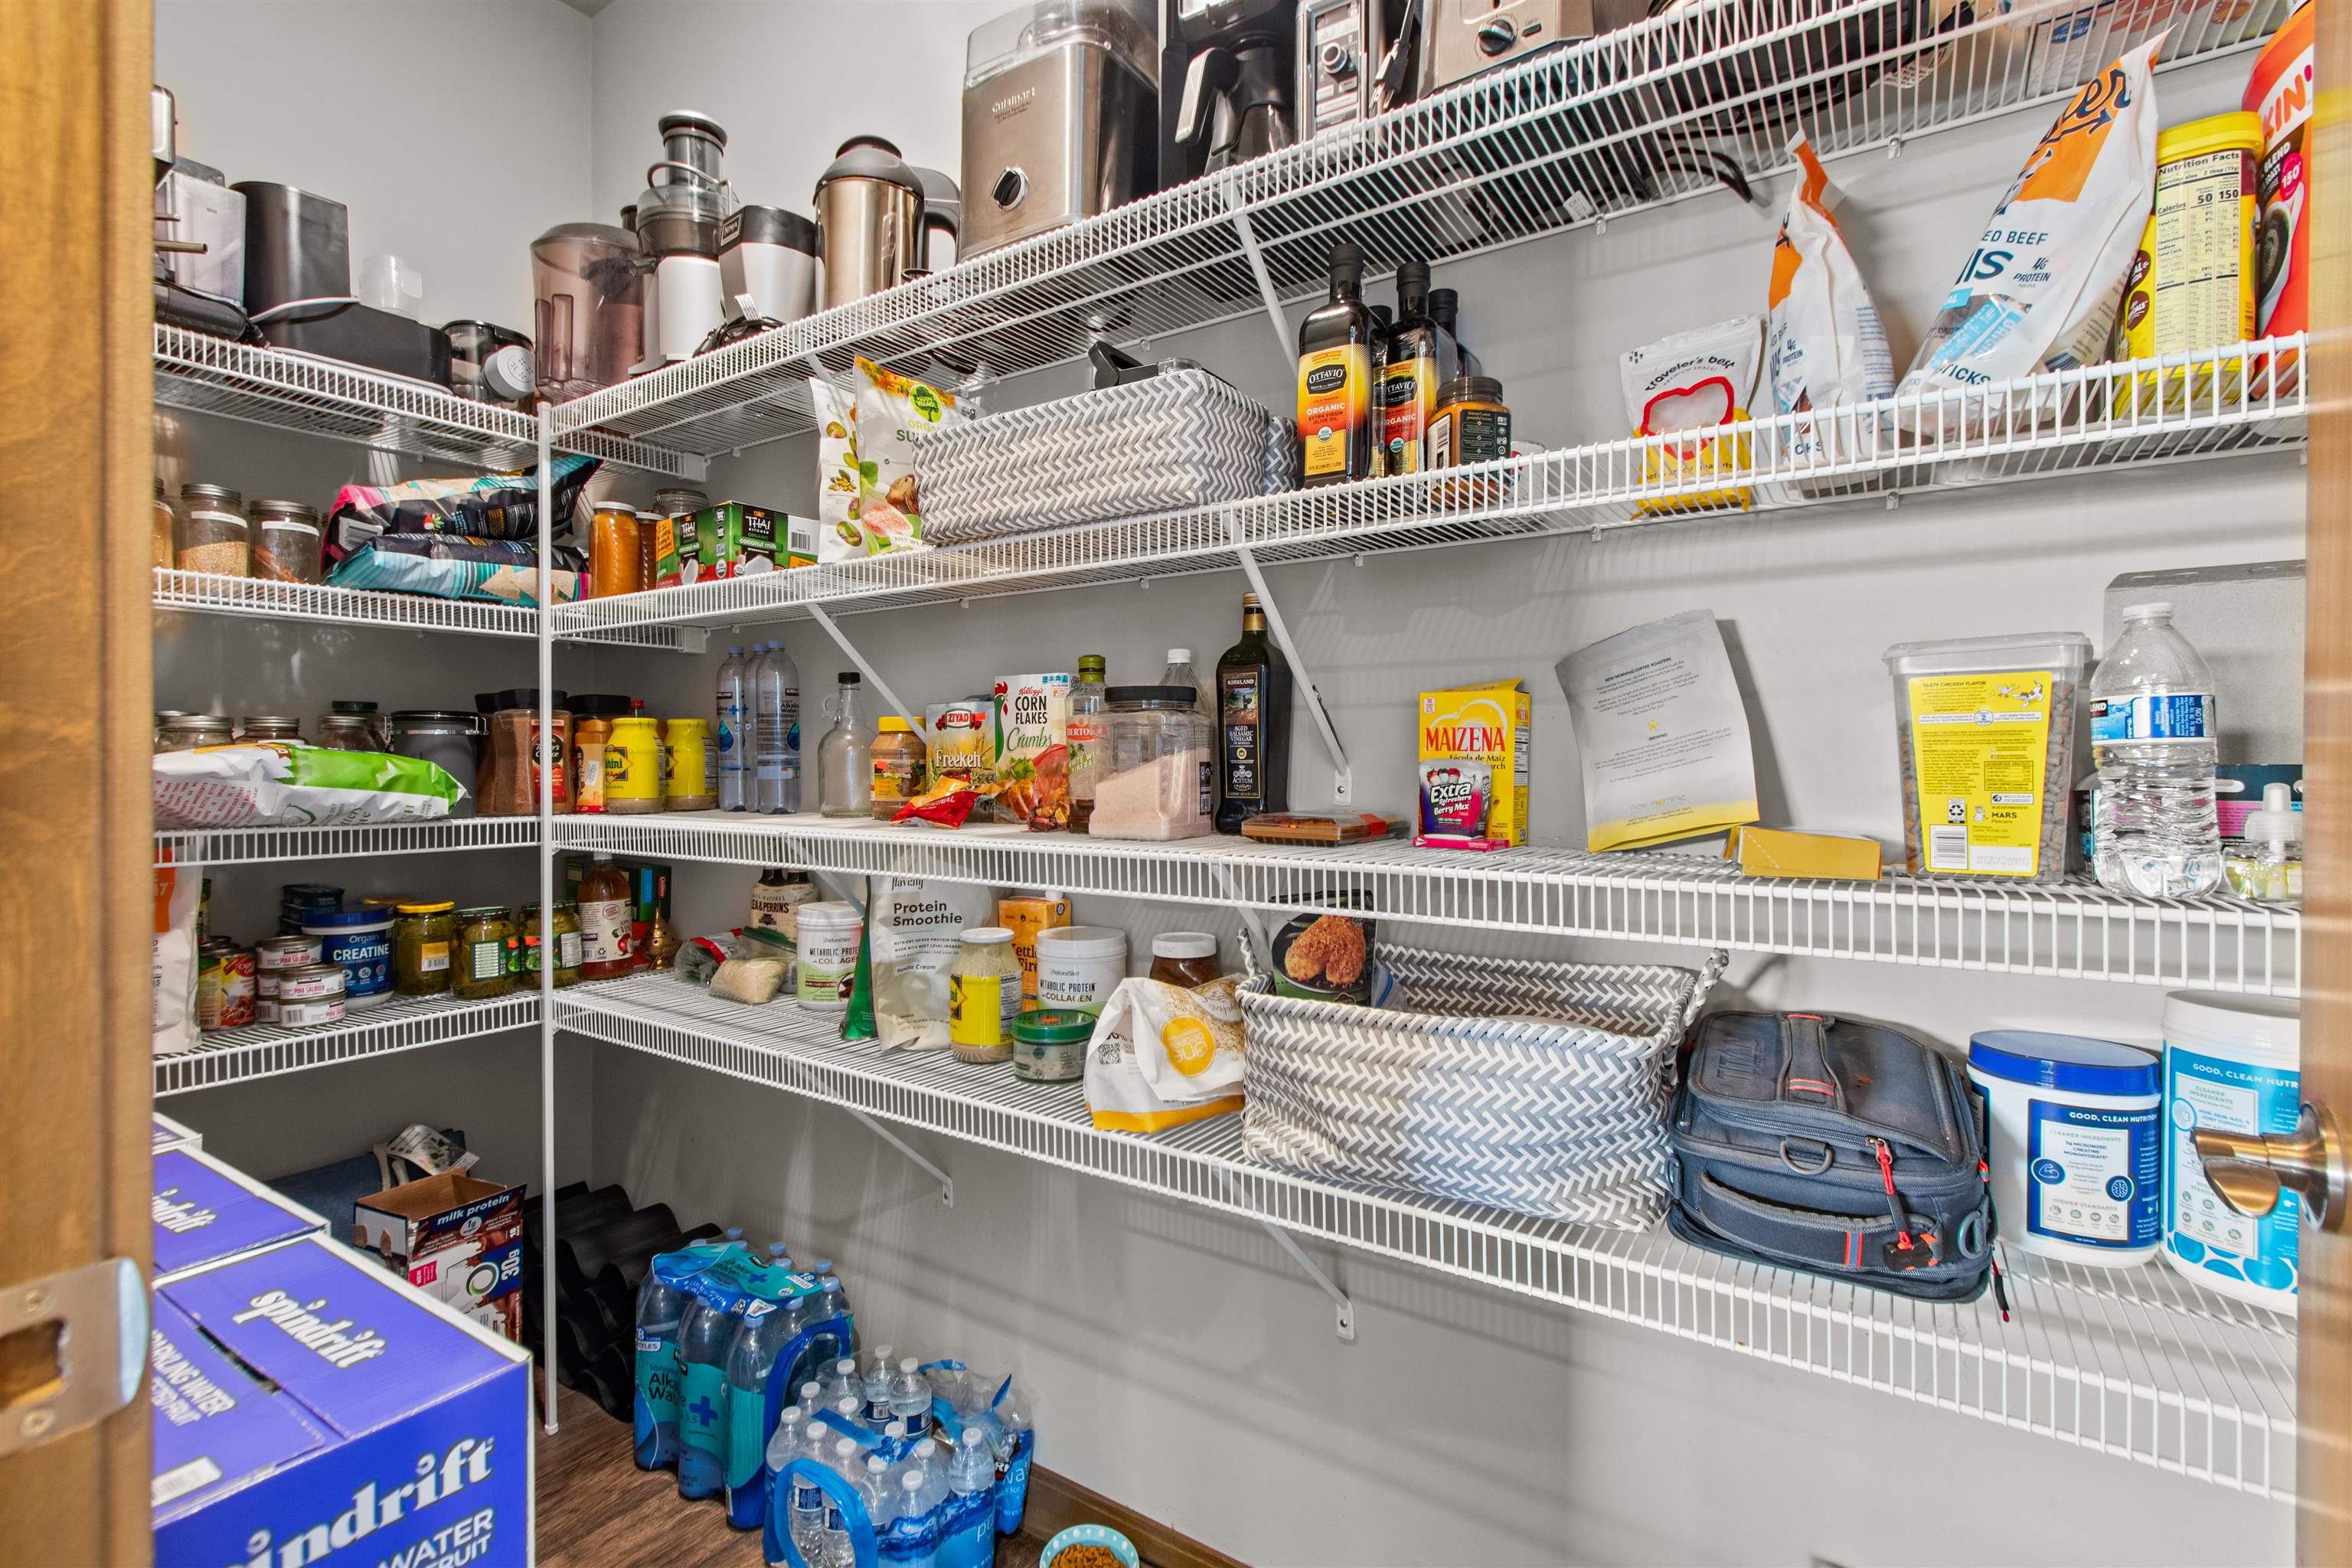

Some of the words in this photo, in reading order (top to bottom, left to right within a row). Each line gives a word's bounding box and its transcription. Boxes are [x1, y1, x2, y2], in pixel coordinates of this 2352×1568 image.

[2158, 158, 2209, 176] Nutrition
[2212, 152, 2239, 162] Facts
[2264, 142, 2291, 173] BLEND
[2281, 162, 2300, 188] 150
[2198, 194, 2213, 204] 50
[2220, 189, 2239, 199] 150
[2158, 202, 2187, 214] Calories
[2006, 230, 2048, 245] BEEF
[2032, 257, 2049, 270] 4G
[2013, 273, 2051, 283] PROTEIN
[1782, 349, 1803, 364] PROTEIN
[1308, 368, 1344, 384] OTTAVIO
[1645, 356, 1704, 392] traveler's
[1708, 355, 1736, 369] best
[1387, 381, 1414, 393] TTAVIO
[1306, 402, 1346, 416] ORGANIC
[1308, 413, 1325, 422] EXTRA
[681, 522, 695, 534] THAI
[745, 515, 771, 530] THAI
[740, 537, 764, 547] coconut
[1615, 668, 1635, 679] MORNING
[1635, 664, 1650, 673] COFFEE
[1651, 657, 1671, 667] ROASTERS
[1019, 686, 1044, 697] Kellogg's
[1015, 695, 1047, 711] CORN
[948, 714, 969, 723] ZIYAD
[1015, 711, 1047, 725] FLAKES
[1067, 728, 1091, 737] BERTO
[1648, 733, 1668, 741] BREWING
[1007, 727, 1052, 752] Crumbs
[1425, 727, 1506, 752] MAIZENA
[936, 750, 981, 768] Freekeh
[1487, 753, 1506, 762] Maíz
[1430, 782, 1472, 802] Extra
[1439, 795, 1472, 805] Refreshers
[1434, 805, 1453, 815] Berry
[1454, 803, 1469, 812] Mix
[893, 900, 947, 914] Protein
[893, 913, 962, 926] Smoothie
[348, 933, 379, 943] Orgain
[333, 943, 390, 961] CREATINE
[810, 948, 839, 956] METABOLIC
[841, 946, 858, 956] PROTE
[292, 955, 310, 963] SALMON
[897, 965, 914, 974] Vanilla
[1040, 981, 1066, 991] METABOLIC
[1069, 983, 1096, 992] PROTEIN
[2193, 1063, 2223, 1076] GOOD,
[2226, 1070, 2262, 1083] CLEAN
[2195, 1086, 2225, 1096] CLEANER
[2190, 1091, 2233, 1105] INGREDIENTS
[2069, 1112, 2100, 1122] GOOD,
[2219, 1118, 2248, 1129] SUPPORT
[2050, 1129, 2079, 1138] CLEANER
[2081, 1134, 2122, 1142] INGREDIENTS
[437, 1210, 464, 1226] milk
[466, 1194, 510, 1216] protein
[2053, 1198, 2078, 1207] HIGHER
[2080, 1203, 2118, 1211] STANDARDS
[467, 1220, 476, 1229] 1g
[501, 1249, 520, 1281] 30g
[233, 1289, 387, 1368] spindrift
[179, 1375, 236, 1417] WATER
[377, 1508, 494, 1568] WATER
